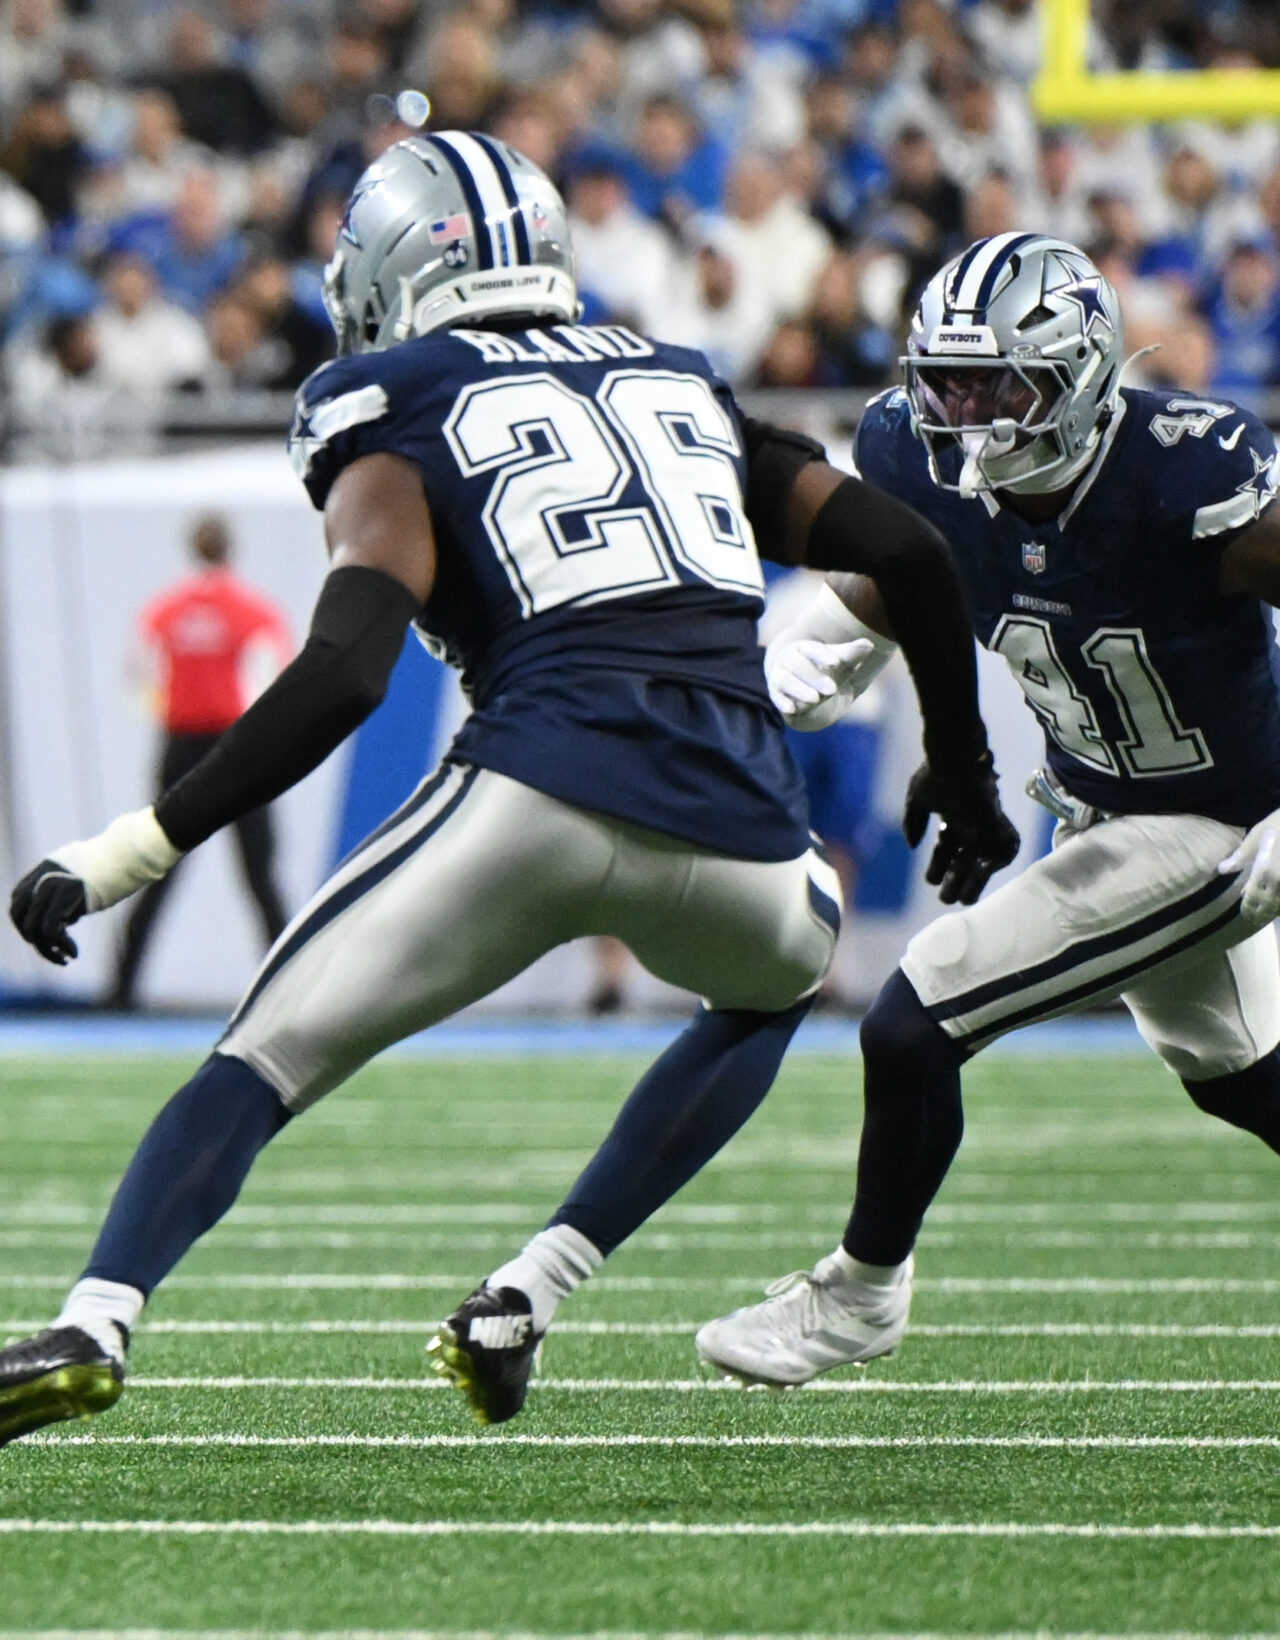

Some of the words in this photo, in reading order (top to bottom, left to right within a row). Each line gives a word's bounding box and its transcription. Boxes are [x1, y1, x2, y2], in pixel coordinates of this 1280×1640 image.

[471, 280, 514, 291] CHOOSE
[517, 276, 541, 287] LOVE
[450, 325, 655, 363] BLAND
[938, 333, 982, 343] COWBOYS
[1148, 398, 1236, 448] 41
[441, 368, 766, 621] 26
[987, 612, 1215, 779] 41
